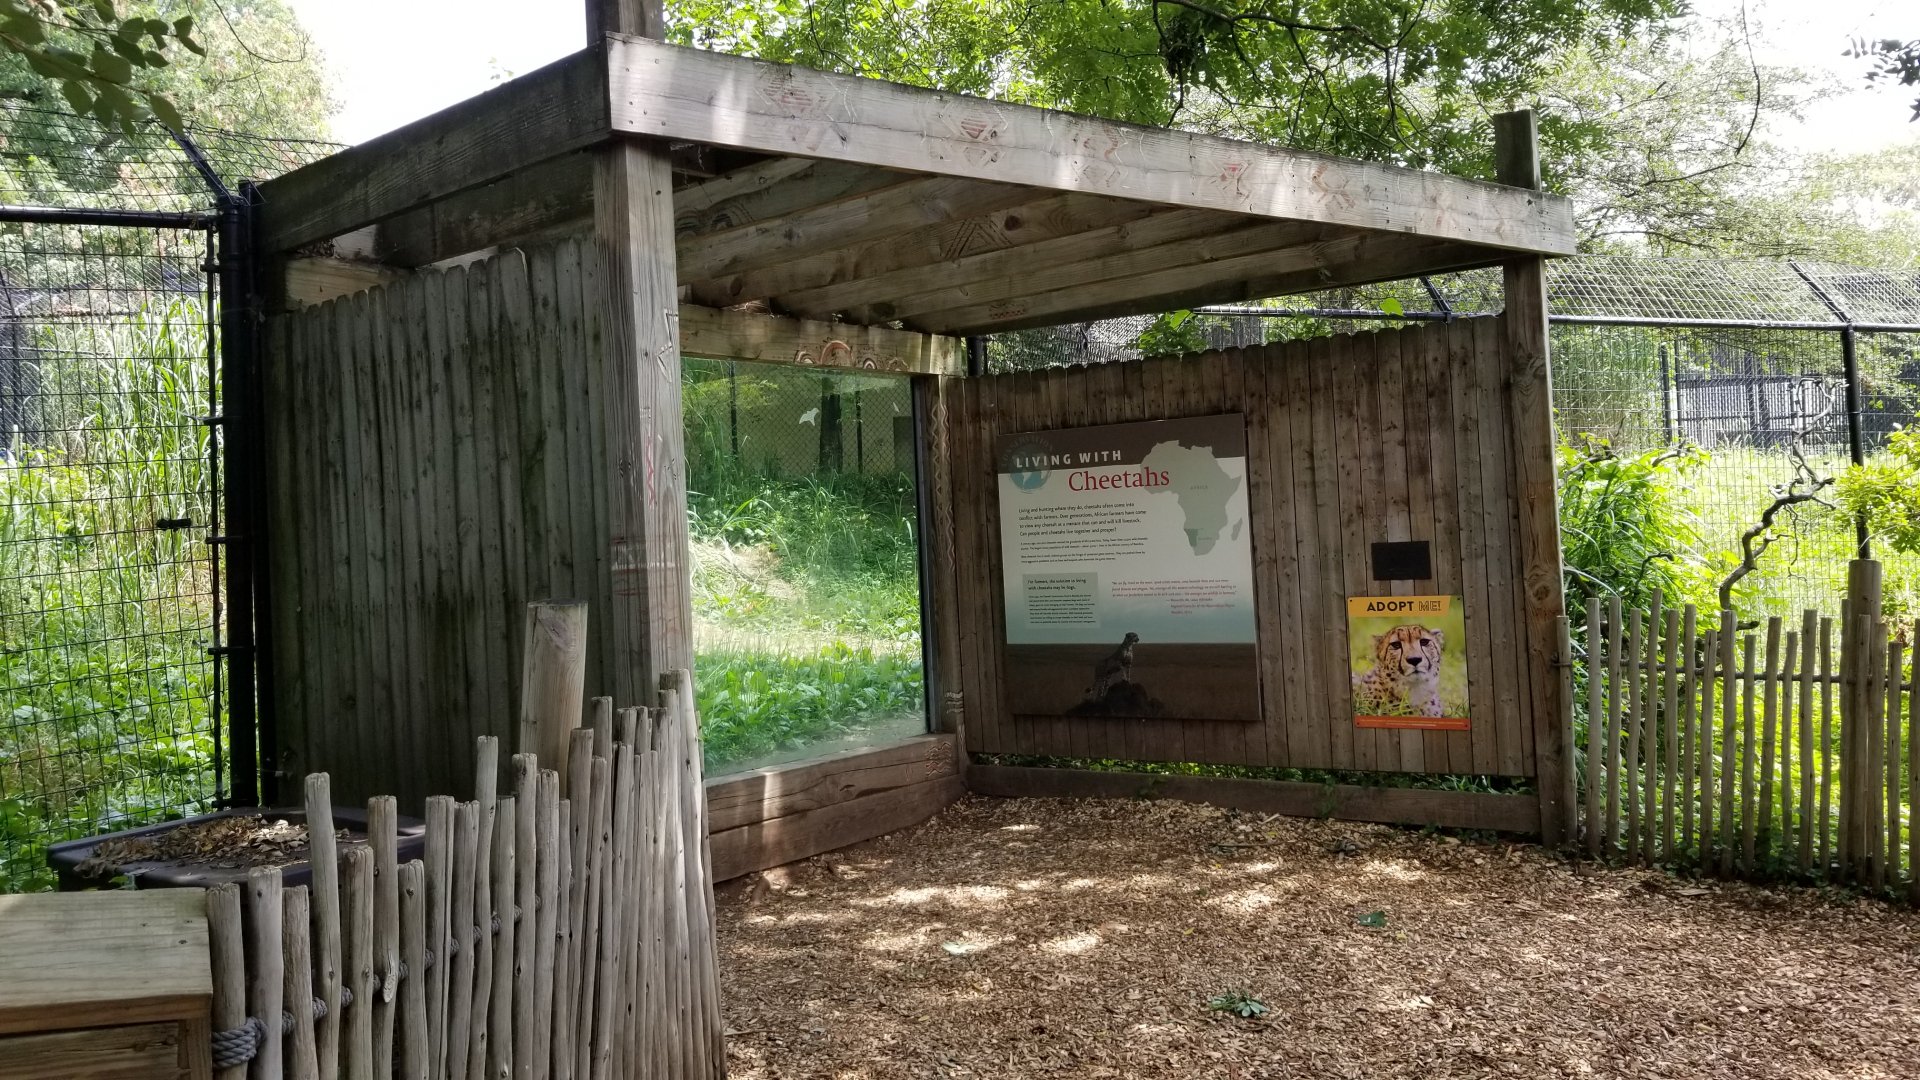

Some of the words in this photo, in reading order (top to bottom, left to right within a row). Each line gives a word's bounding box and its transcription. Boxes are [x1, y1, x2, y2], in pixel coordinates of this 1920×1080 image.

[1016, 453, 1072, 468] LIVING
[1079, 450, 1122, 464] WITH
[1068, 467, 1170, 492] Cheetahs
[1366, 600, 1414, 612] ADOPT
[1418, 600, 1441, 611] ME!
